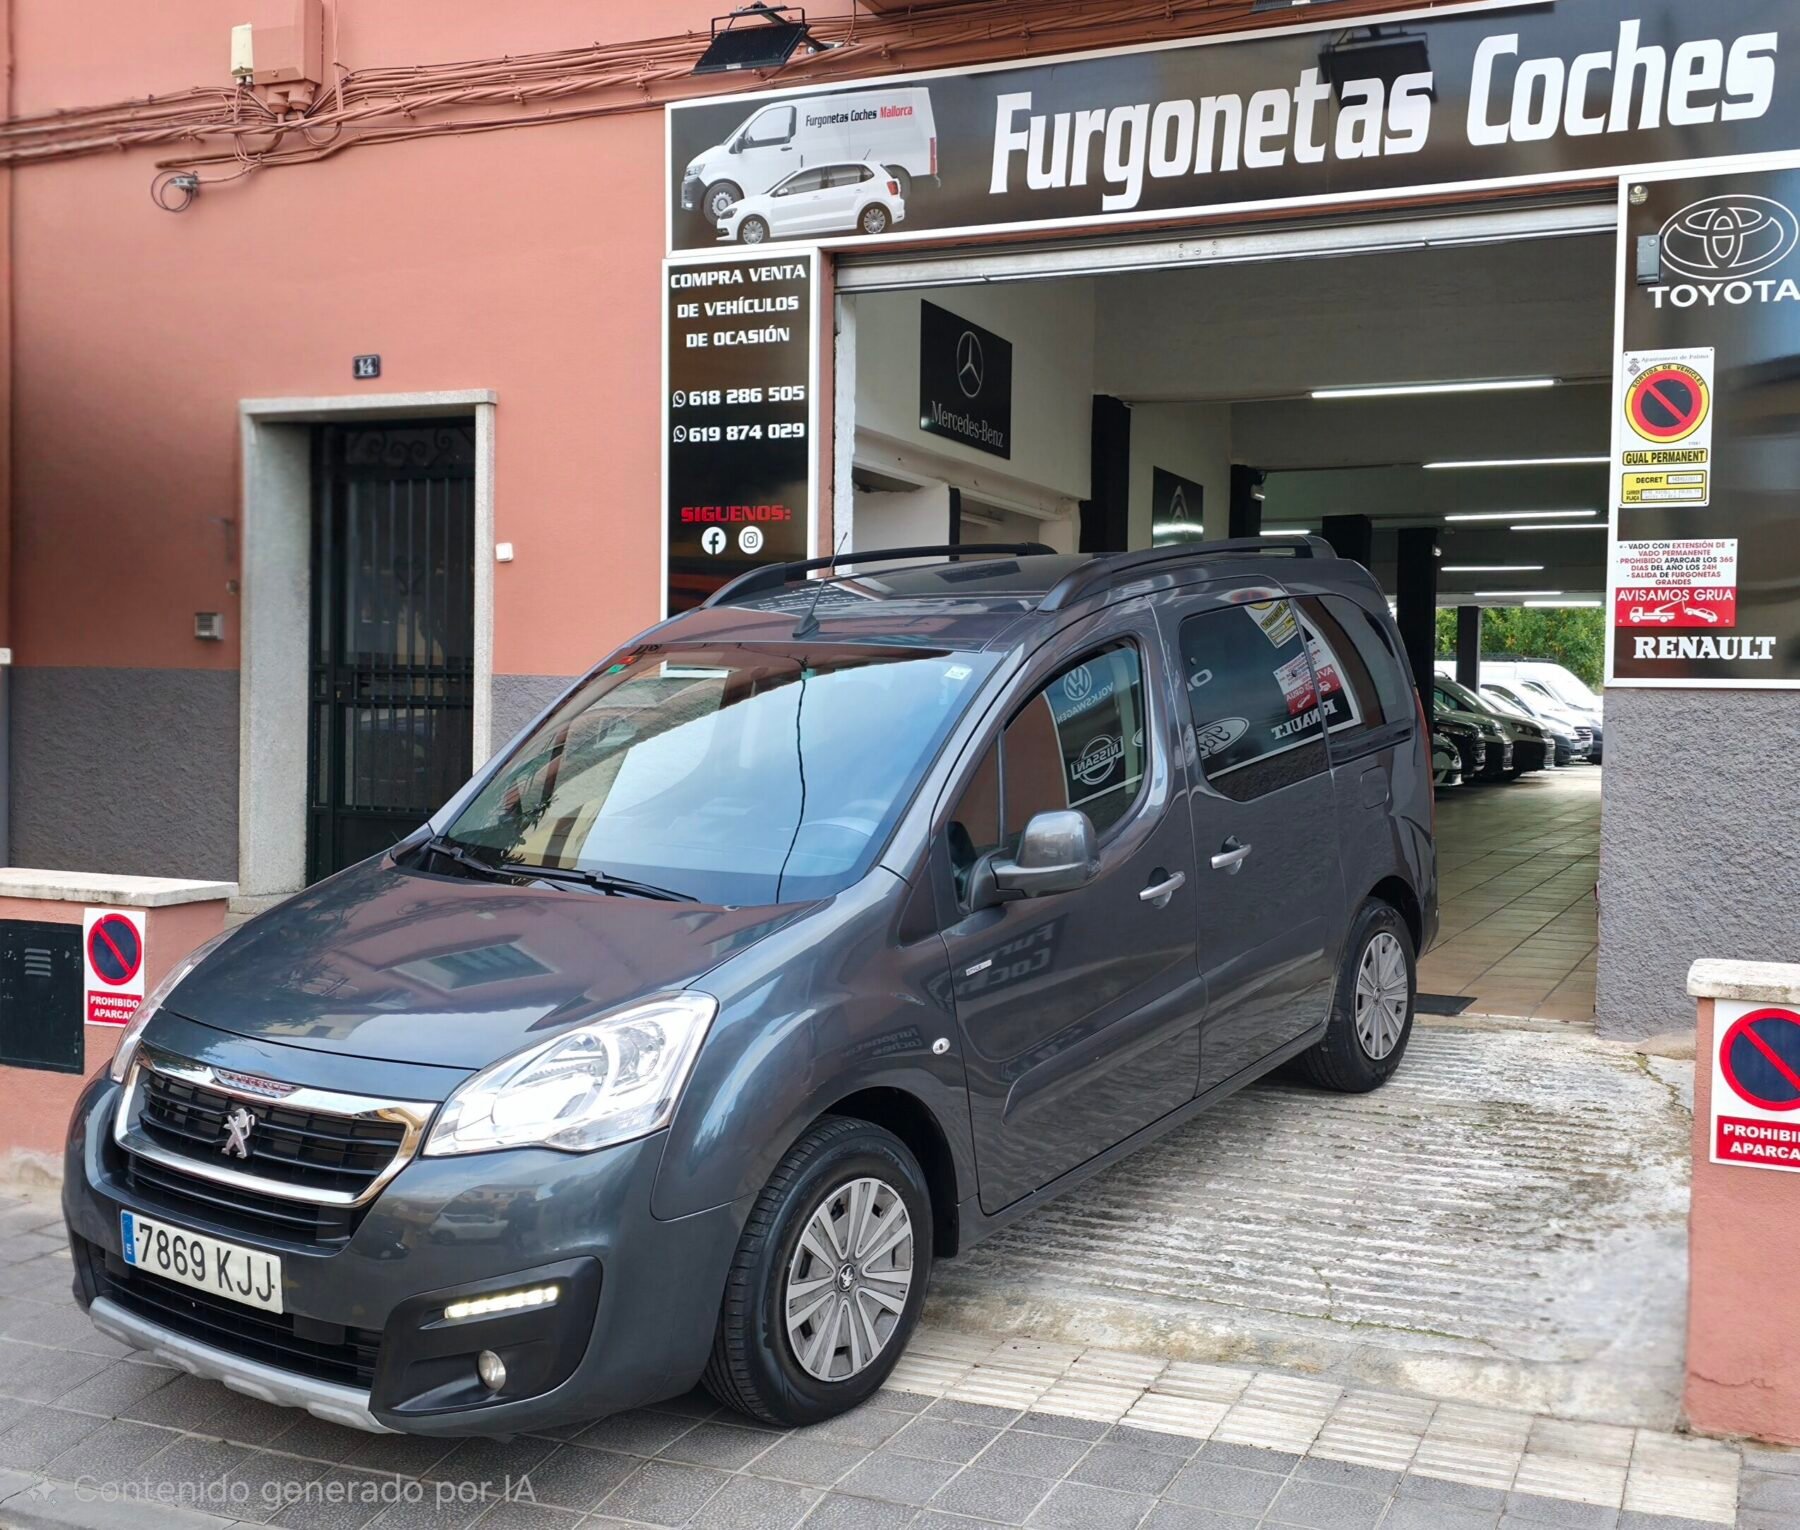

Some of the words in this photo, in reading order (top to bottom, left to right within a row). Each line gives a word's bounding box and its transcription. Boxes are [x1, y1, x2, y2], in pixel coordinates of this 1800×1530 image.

[805, 113, 849, 128] Furgonetas
[850, 107, 877, 122] Coches
[879, 105, 913, 118] Mallorca
[989, 71, 1433, 212] Furgonetas
[1466, 19, 1778, 146] Coches
[670, 269, 743, 288] COMPRA
[749, 264, 806, 282] VENTA
[1647, 278, 1800, 309] TOYOTA
[677, 303, 699, 318] DE
[704, 296, 799, 316] VEHÍCULOS
[686, 333, 708, 347] DE
[713, 326, 790, 346] OCASIÓN
[1632, 367, 1658, 388] SORTIDA
[1676, 365, 1704, 387] VEHICLES
[688, 391, 720, 405] 618
[726, 389, 762, 403] 286
[768, 386, 805, 401] 505
[688, 427, 720, 442] 619
[726, 425, 762, 440] 874
[768, 423, 804, 438] 029
[931, 400, 1003, 448] Mercedes-Benz
[1625, 452, 1648, 463] GUAL
[1651, 450, 1704, 463] PERMANENT
[681, 506, 791, 521] SIGUENOS:
[1672, 541, 1713, 549] EXTENSIÓN
[1664, 556, 1700, 564] APARCAR
[1666, 563, 1683, 571] AÑO
[1617, 589, 1690, 601] AVISAMOS
[1693, 588, 1733, 600] GRUA
[1633, 636, 1776, 660] RENAULT
[90, 995, 140, 1009] PROHIBIDO
[139, 1223, 206, 1282] 7869
[216, 1247, 273, 1302] KJJ
